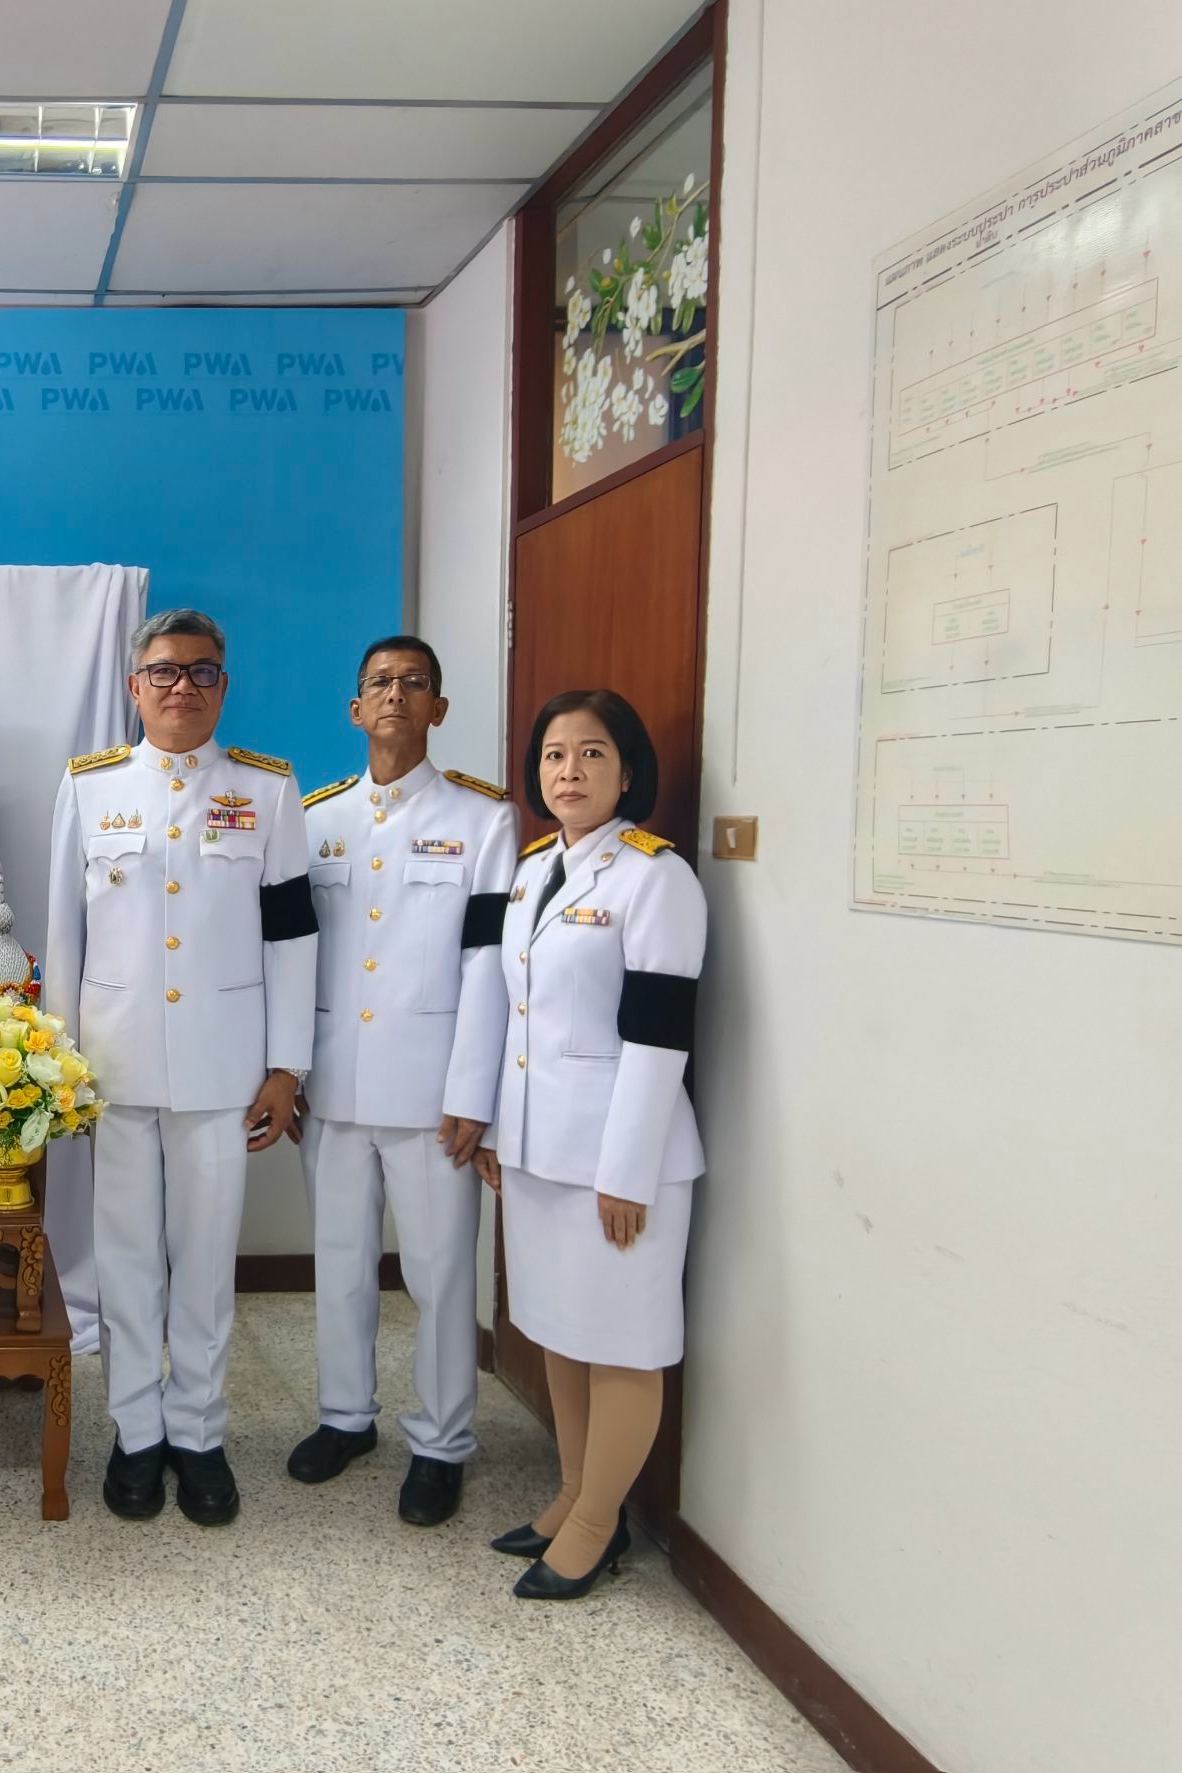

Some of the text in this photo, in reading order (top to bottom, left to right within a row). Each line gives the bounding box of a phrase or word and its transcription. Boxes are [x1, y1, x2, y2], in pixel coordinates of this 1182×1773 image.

[90, 352, 156, 376] PWA
[184, 352, 251, 376] PWA
[278, 353, 345, 376] PWA
[42, 388, 109, 411] PWA
[137, 388, 203, 412] PWA
[230, 388, 297, 412] PWA
[324, 388, 391, 412] PWA
